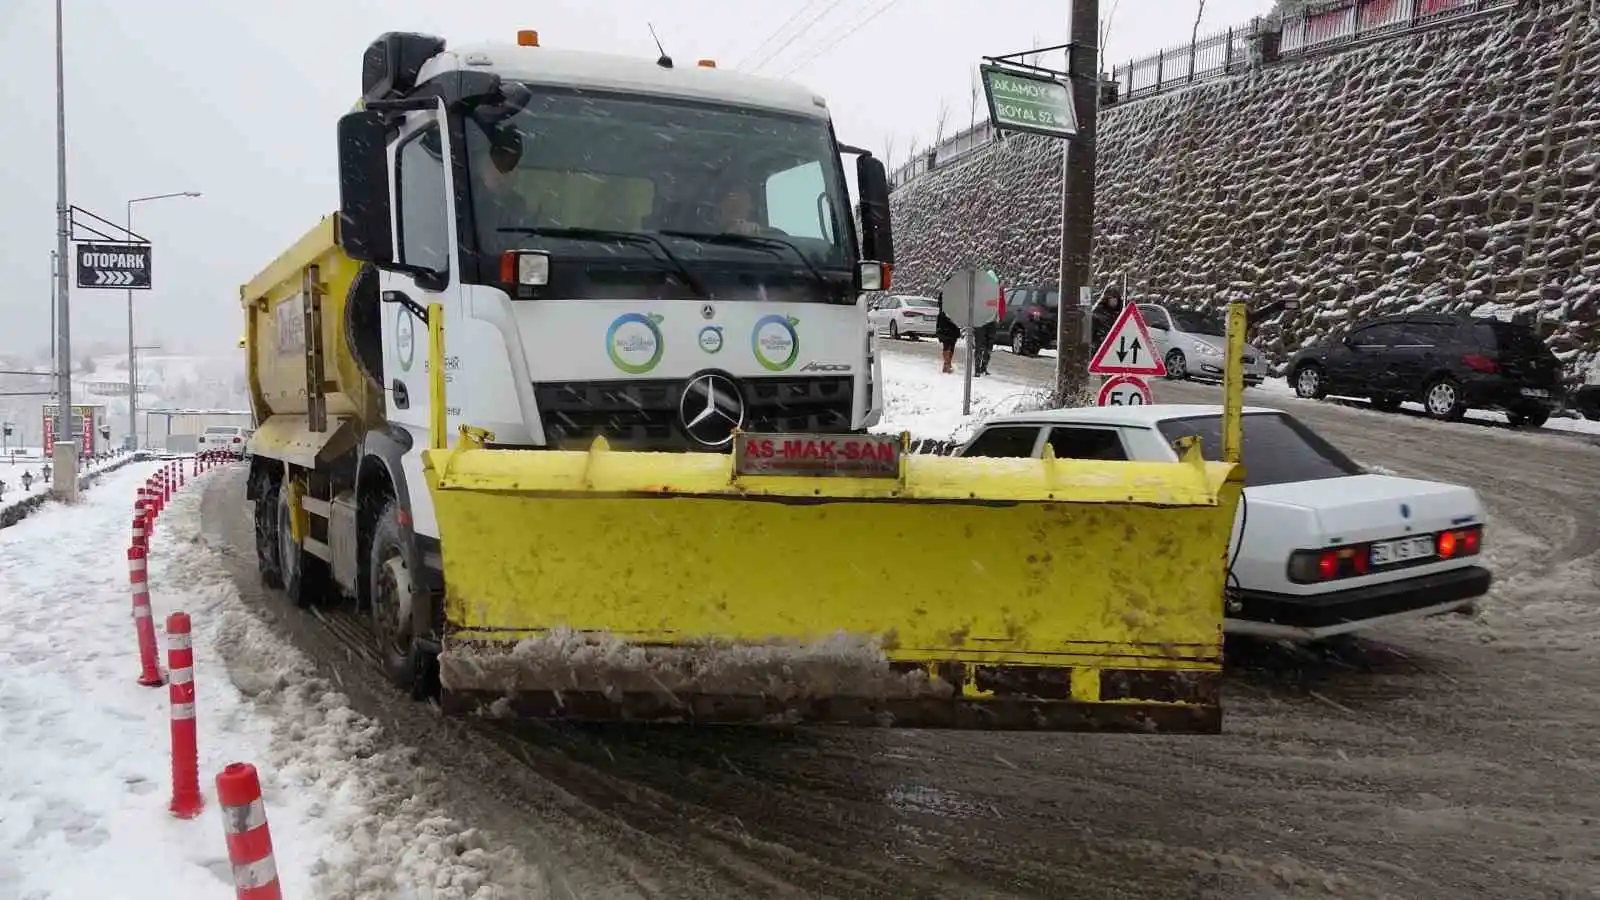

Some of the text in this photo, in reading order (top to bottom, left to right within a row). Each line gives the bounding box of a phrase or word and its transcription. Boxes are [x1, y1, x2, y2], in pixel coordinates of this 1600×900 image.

[998, 103, 1037, 121] ROYAL
[82, 252, 145, 269] OTOPARK
[744, 439, 895, 462] AS-MAK-SAN
